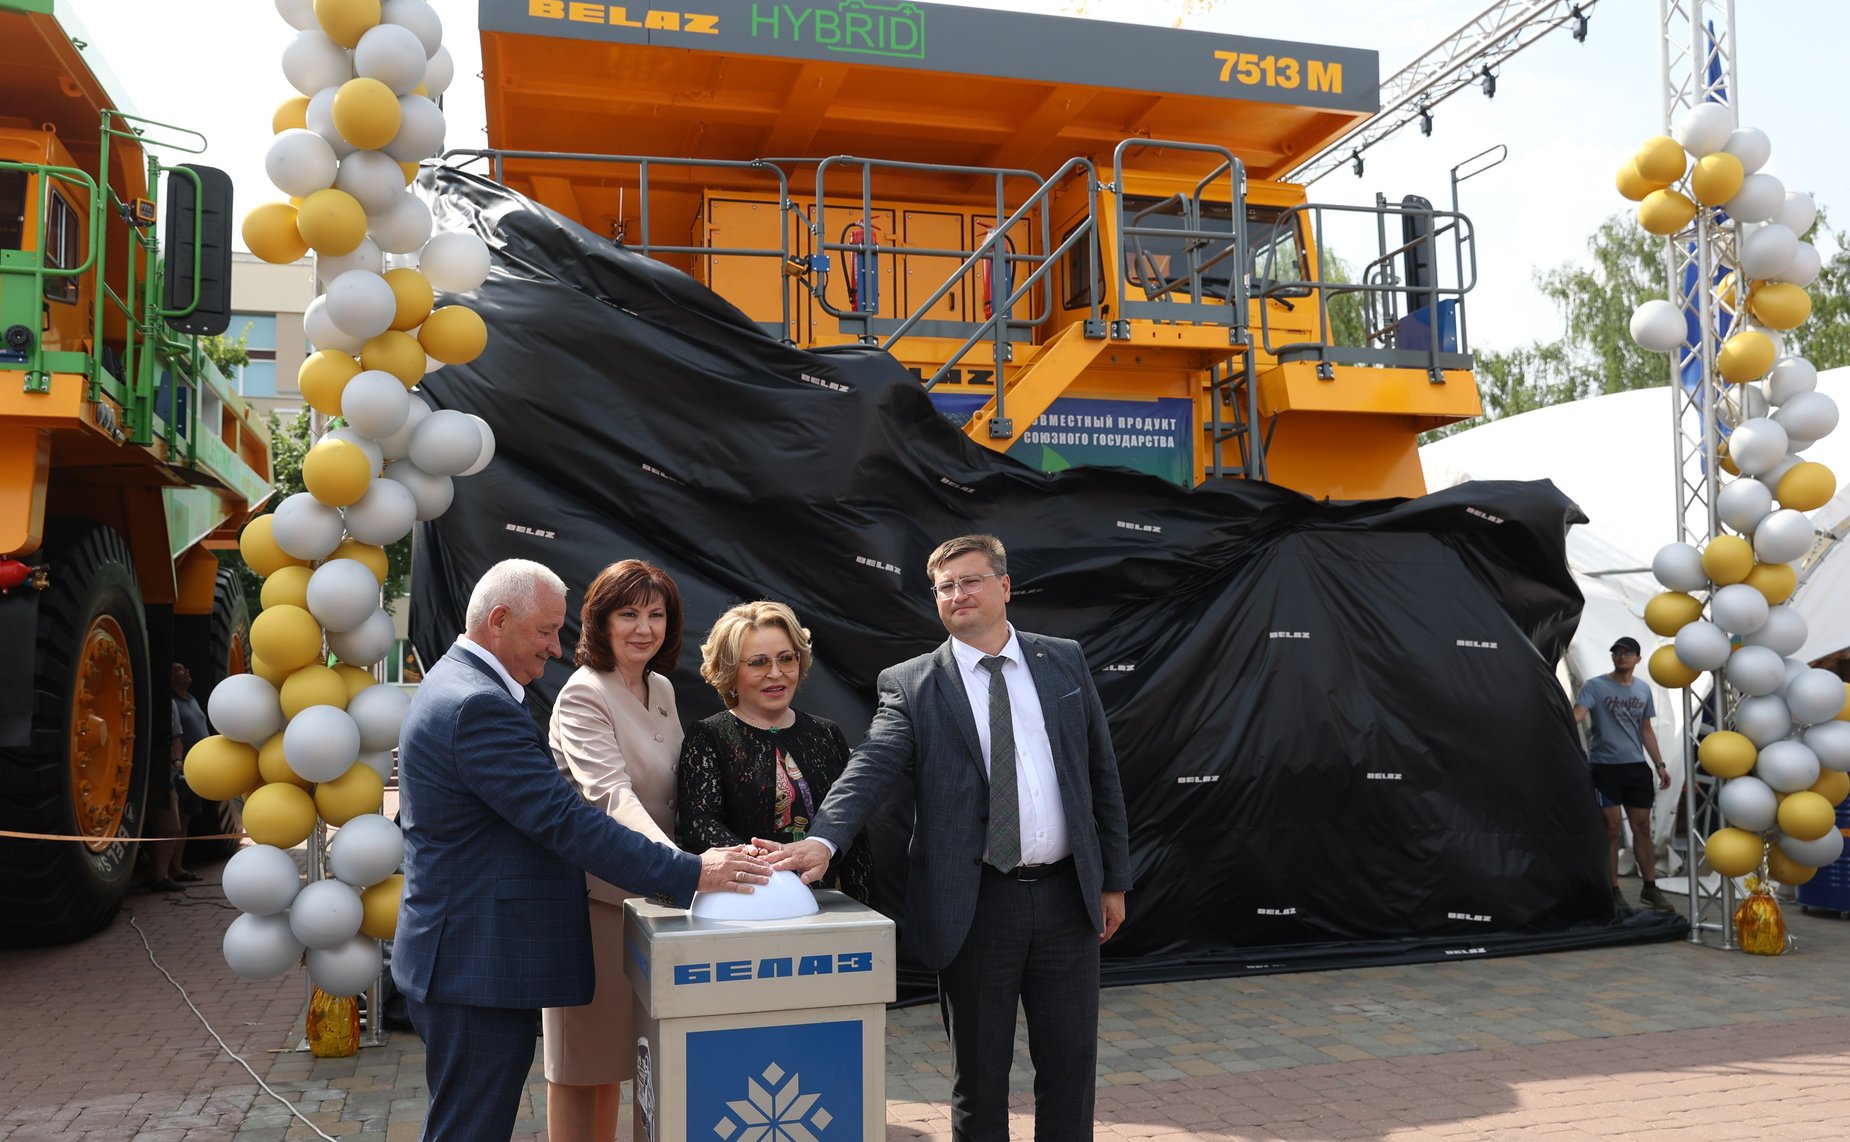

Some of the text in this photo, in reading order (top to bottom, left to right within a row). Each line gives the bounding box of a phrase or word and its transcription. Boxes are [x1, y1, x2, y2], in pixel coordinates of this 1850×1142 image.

[528, 0, 719, 34] BELAZ
[752, 3, 918, 51] HYBRID
[1214, 50, 1342, 94] 7513 M
[801, 373, 850, 393] BELAZ
[908, 367, 995, 385] LAZ
[1031, 414, 1177, 431] ВМЕСТНЫЙ ПРОДУКТ
[1023, 431, 1175, 449] СОЮЗНОГО ГОСУДАРСТВА
[505, 523, 556, 539] BELAZ
[1116, 520, 1162, 533] BELAZ
[855, 555, 902, 575] BELAZ
[1269, 631, 1311, 639] BELAZ
[1456, 639, 1498, 649] BELAZ
[1177, 775, 1220, 784] BELAZ
[1366, 772, 1403, 780] BELAZ
[1256, 907, 1297, 916] BELAZ
[1447, 912, 1492, 922] BELAZ
[673, 951, 873, 985] БЕЛАЗ
